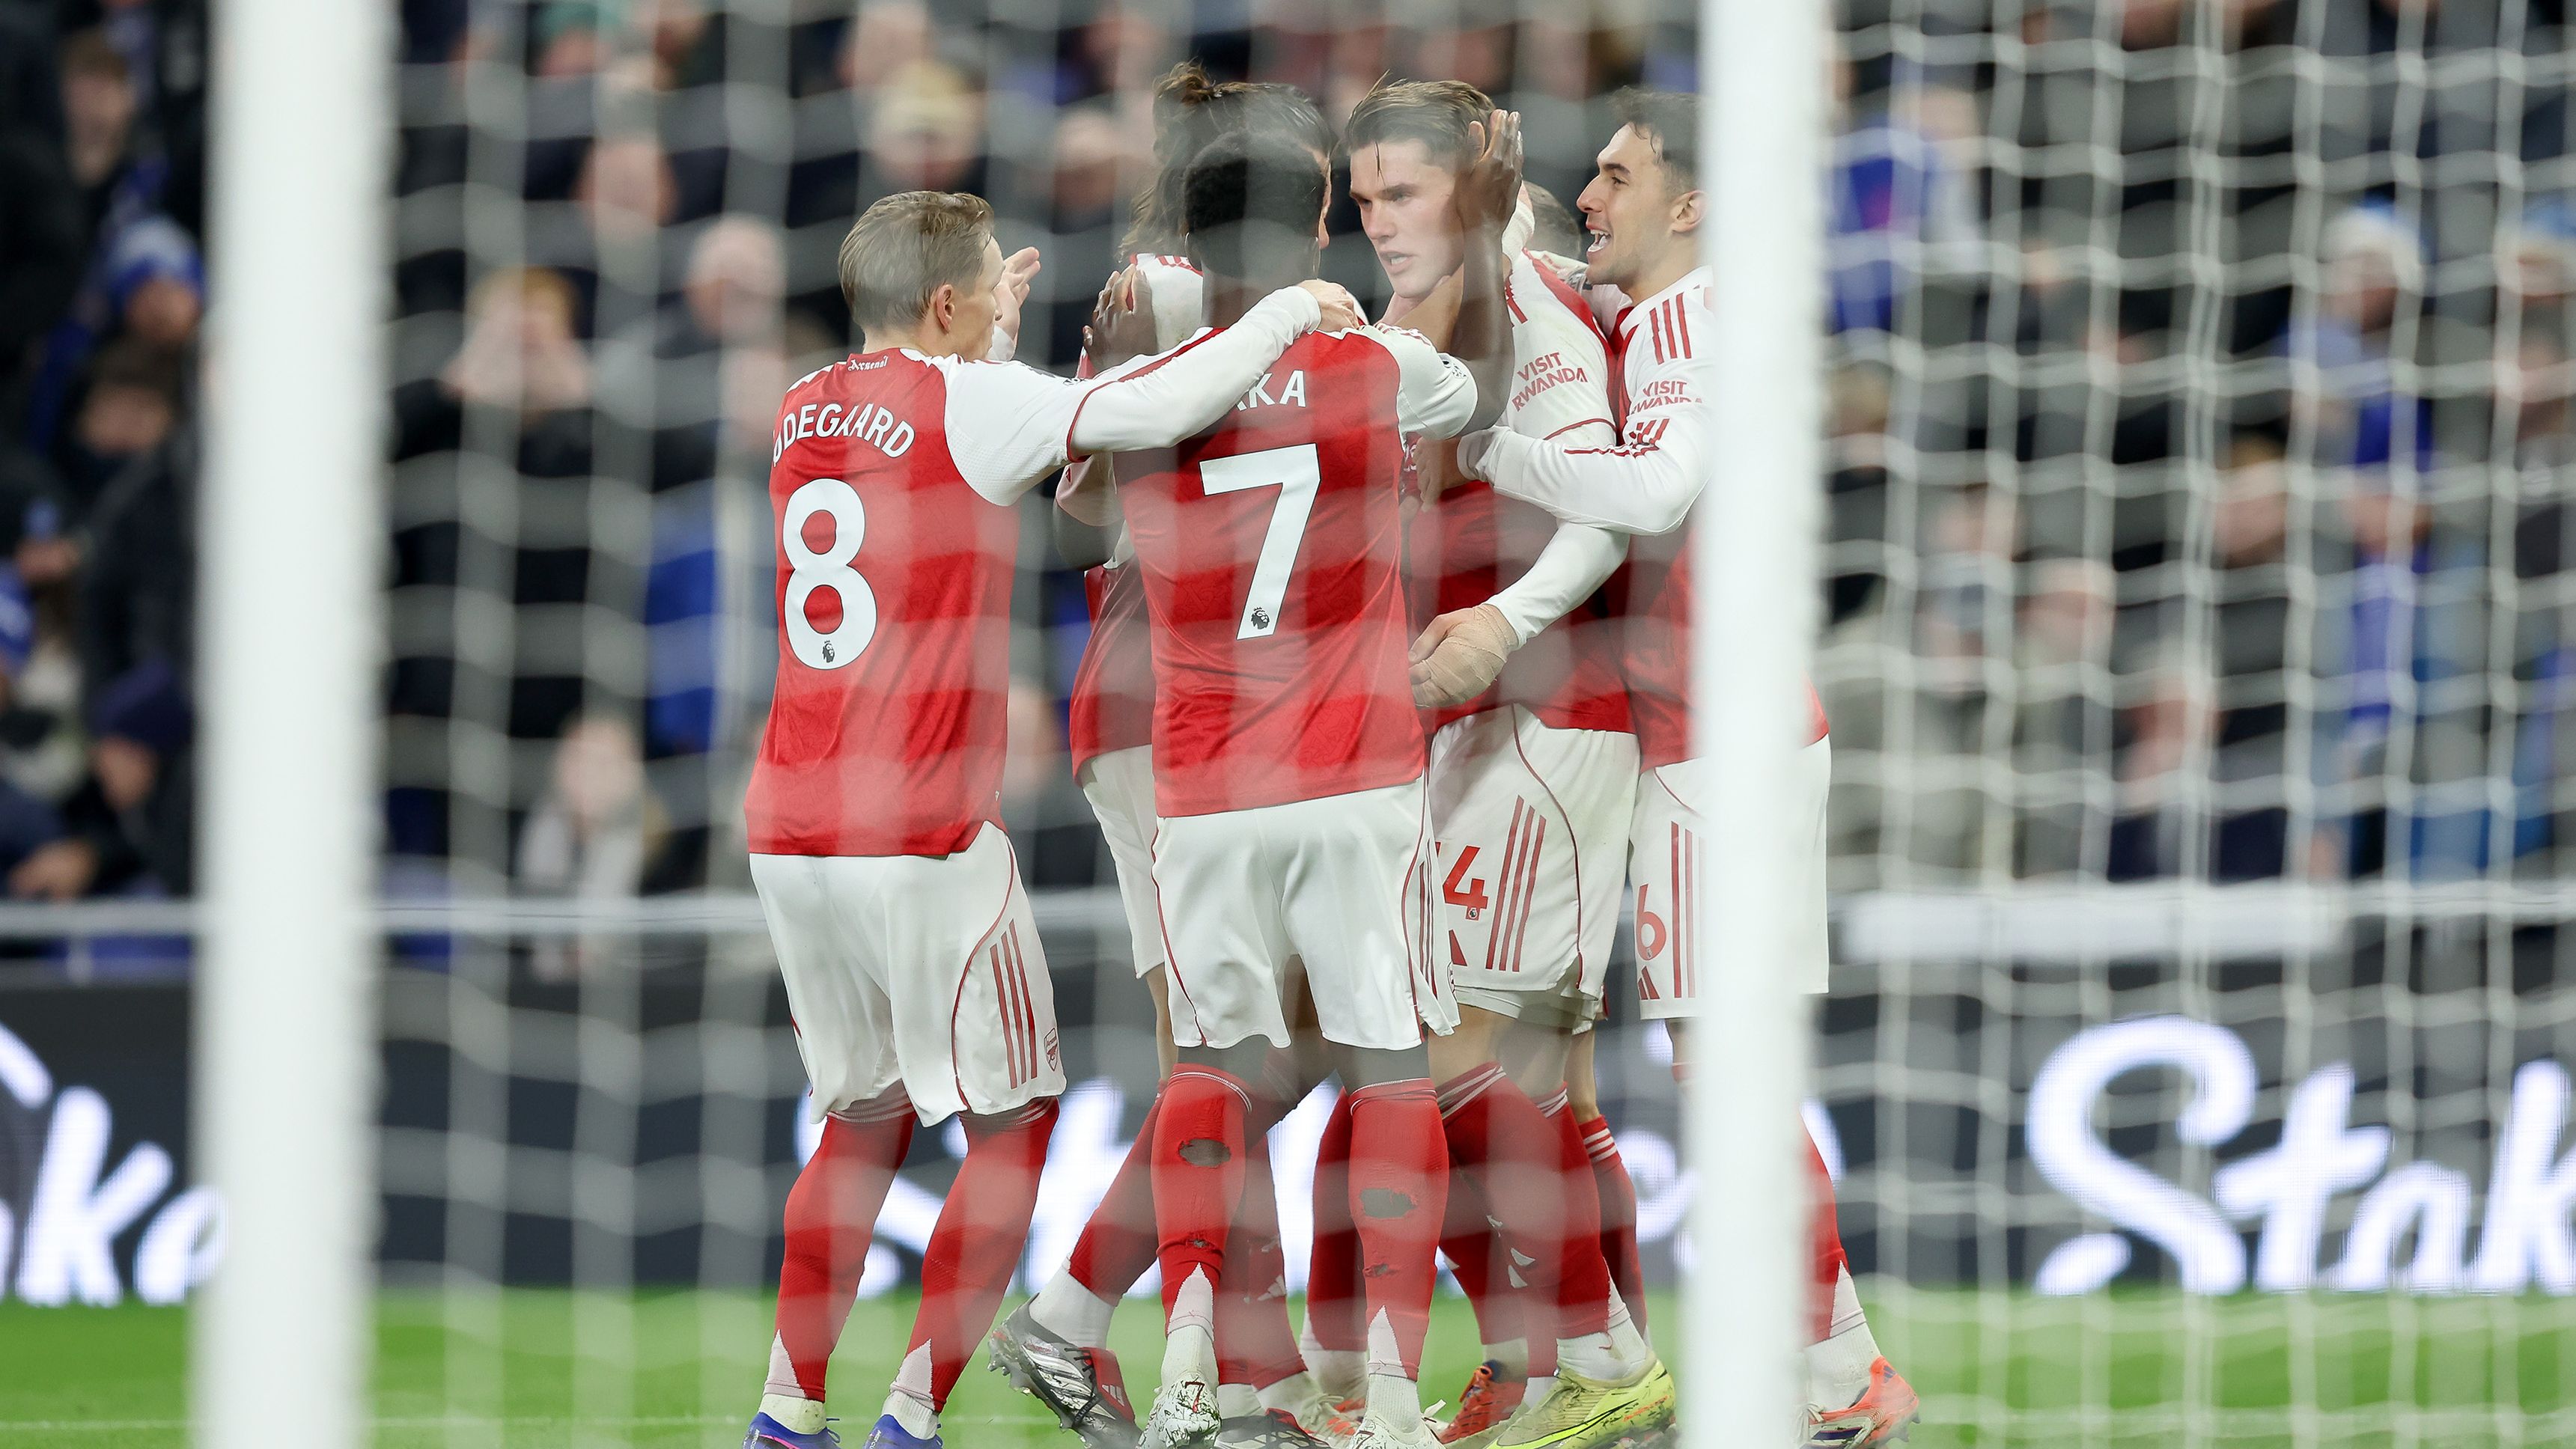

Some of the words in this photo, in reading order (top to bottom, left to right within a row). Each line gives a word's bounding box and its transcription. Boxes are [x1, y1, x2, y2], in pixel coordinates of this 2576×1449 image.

[847, 355, 889, 371] Arsenal
[1517, 352, 1562, 382] VISIT
[1237, 369, 1306, 411] KA
[1511, 367, 1588, 412] RWANDA
[1642, 380, 1687, 397] VISIT
[1199, 442, 1321, 640] 7
[782, 478, 877, 671] 8
[1434, 841, 1488, 921] 4
[1635, 883, 1666, 961] 6
